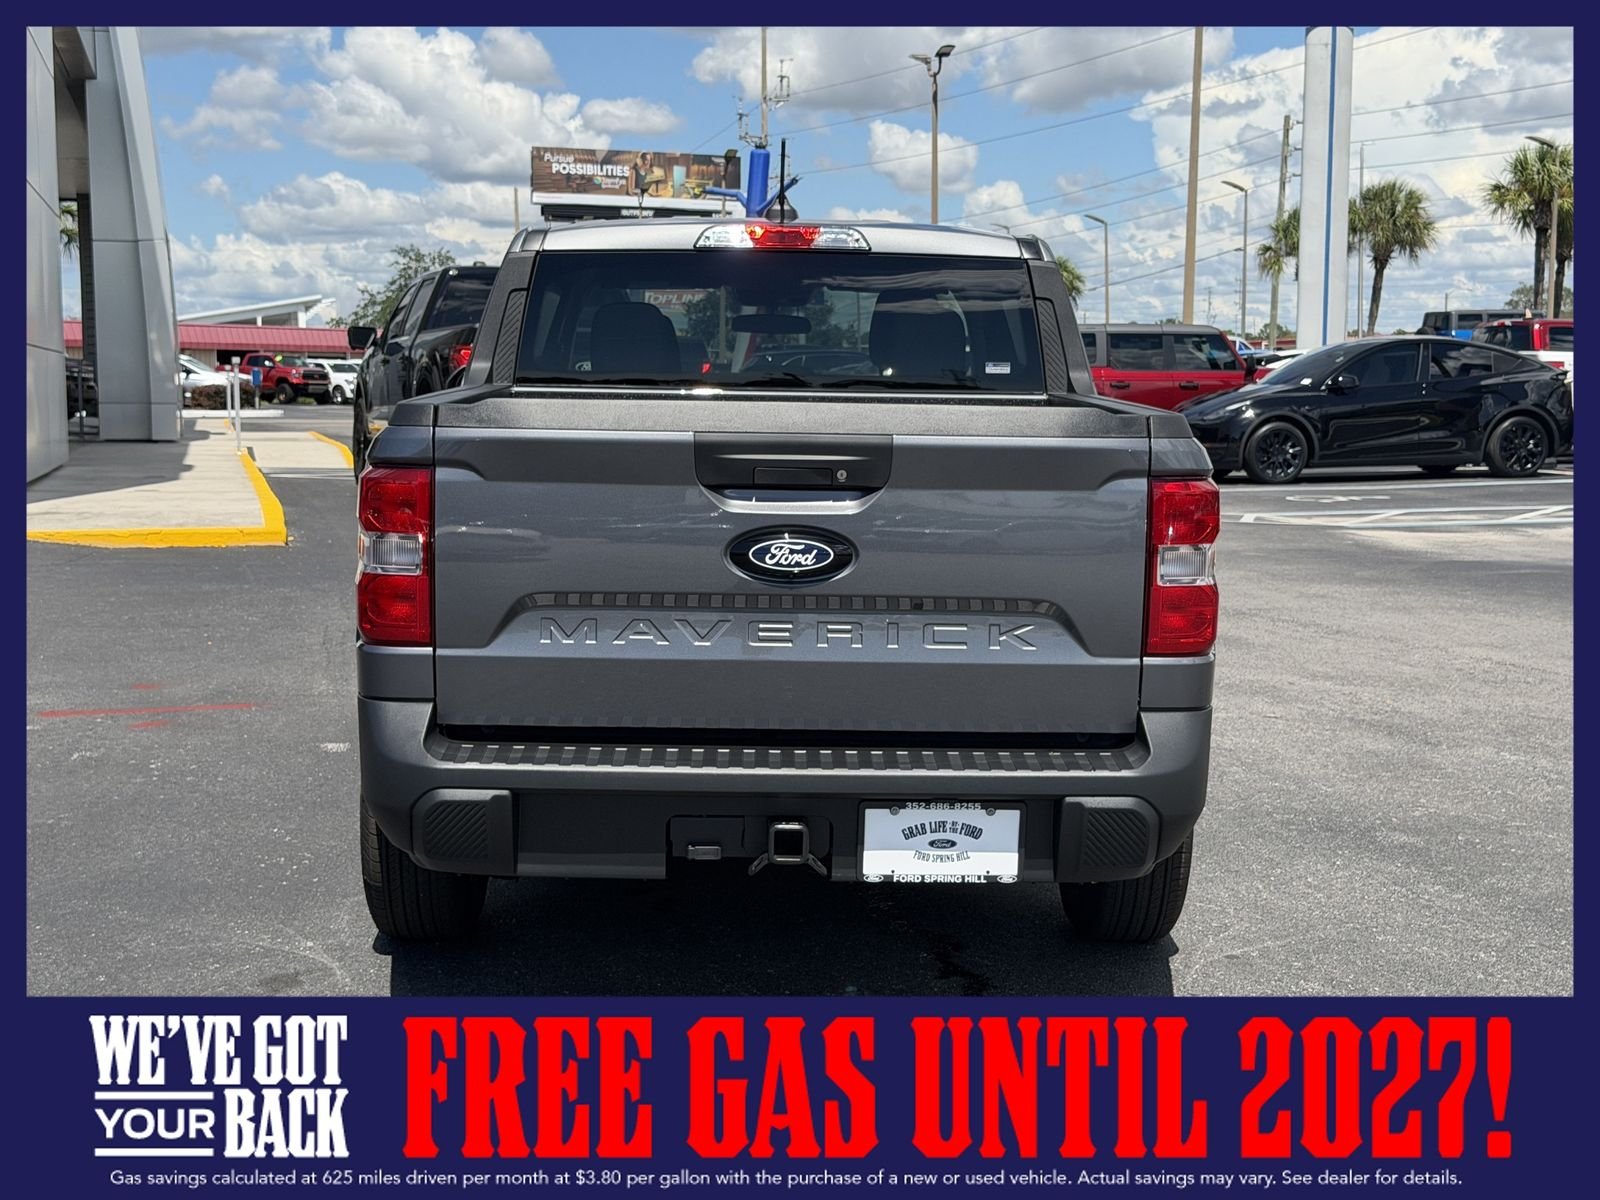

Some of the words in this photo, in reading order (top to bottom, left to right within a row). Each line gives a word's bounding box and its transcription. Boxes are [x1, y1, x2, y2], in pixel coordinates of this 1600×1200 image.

[543, 152, 575, 164] Pursue
[552, 163, 630, 177] POSSIBILITIES
[763, 543, 817, 567] Ford
[539, 616, 1038, 650] MAVERICK
[905, 802, 982, 810] 352-686-8255
[901, 822, 928, 840] GRAB
[929, 820, 948, 834] LIFE
[959, 822, 983, 840] FORD
[913, 850, 931, 862] FORD
[931, 853, 955, 863] SPRING
[956, 850, 971, 860] HILL
[893, 874, 923, 883] FORD
[924, 874, 963, 883] SPRING
[964, 875, 987, 884] HILL
